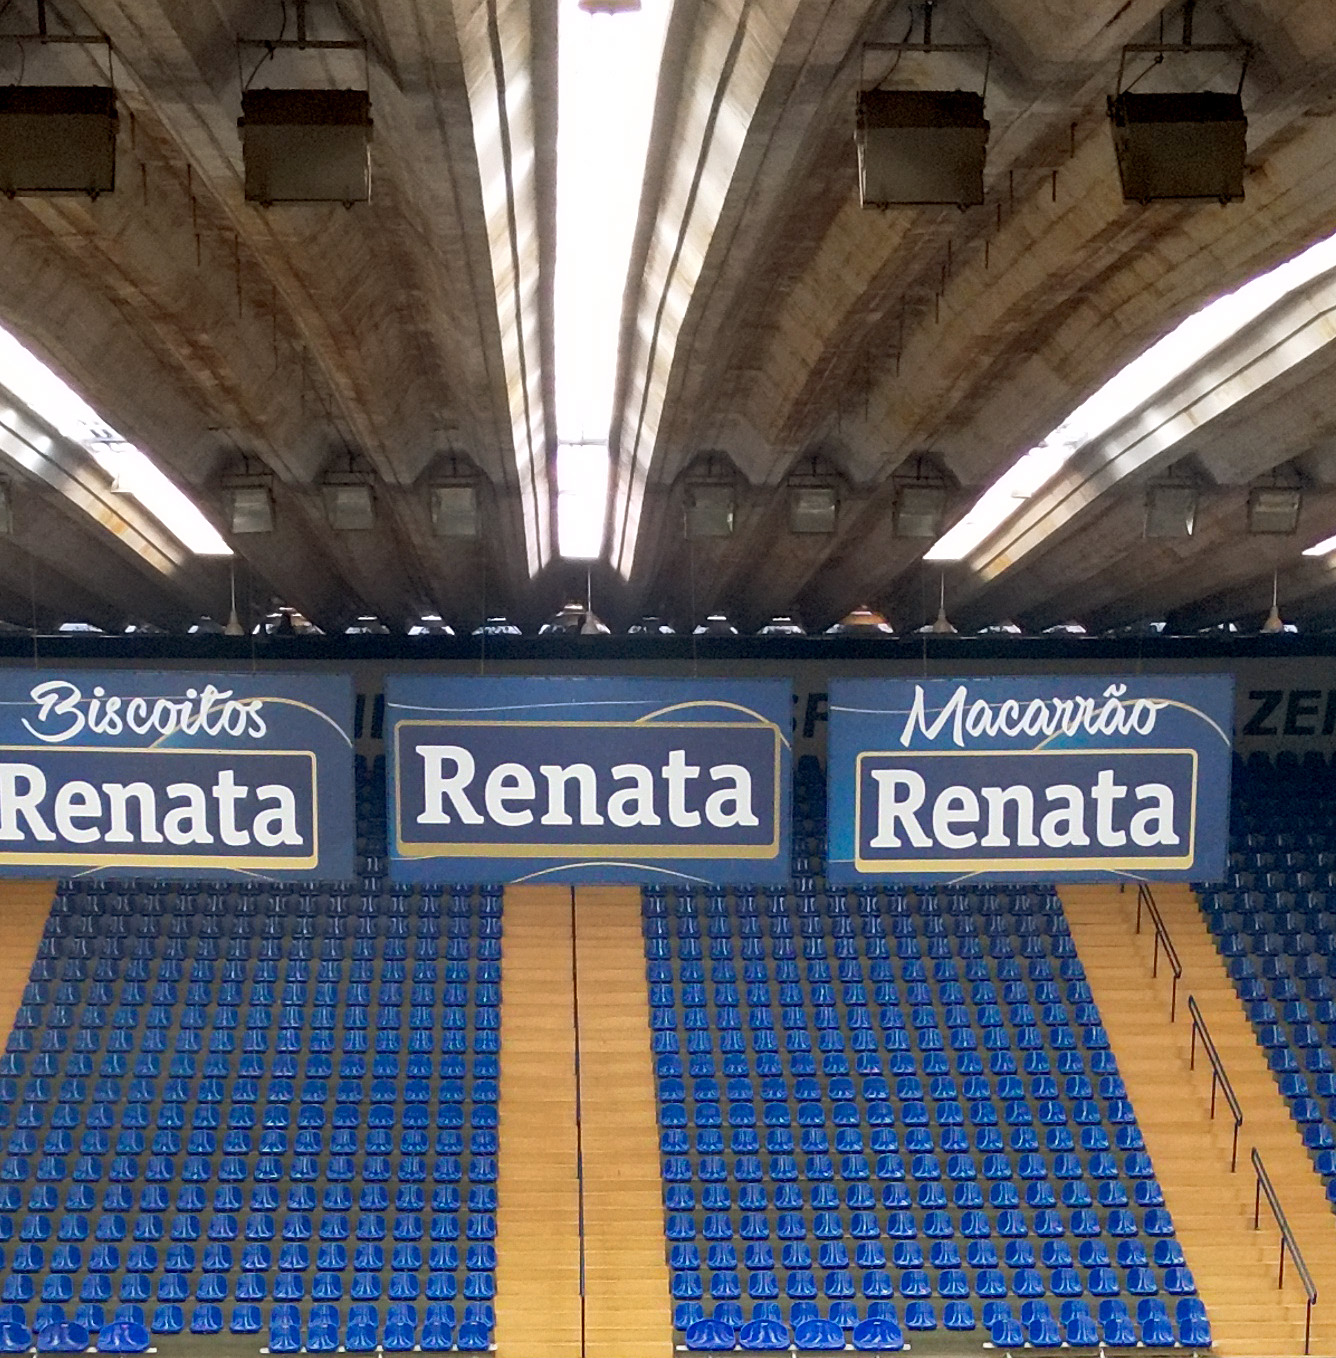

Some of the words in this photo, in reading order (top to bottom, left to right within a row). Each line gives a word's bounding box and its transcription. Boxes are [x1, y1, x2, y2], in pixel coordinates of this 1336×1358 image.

[21, 680, 267, 743] Biscoitos
[899, 684, 1168, 747] Macarrão
[415, 745, 759, 828] Renata
[869, 769, 1179, 849] Renata
